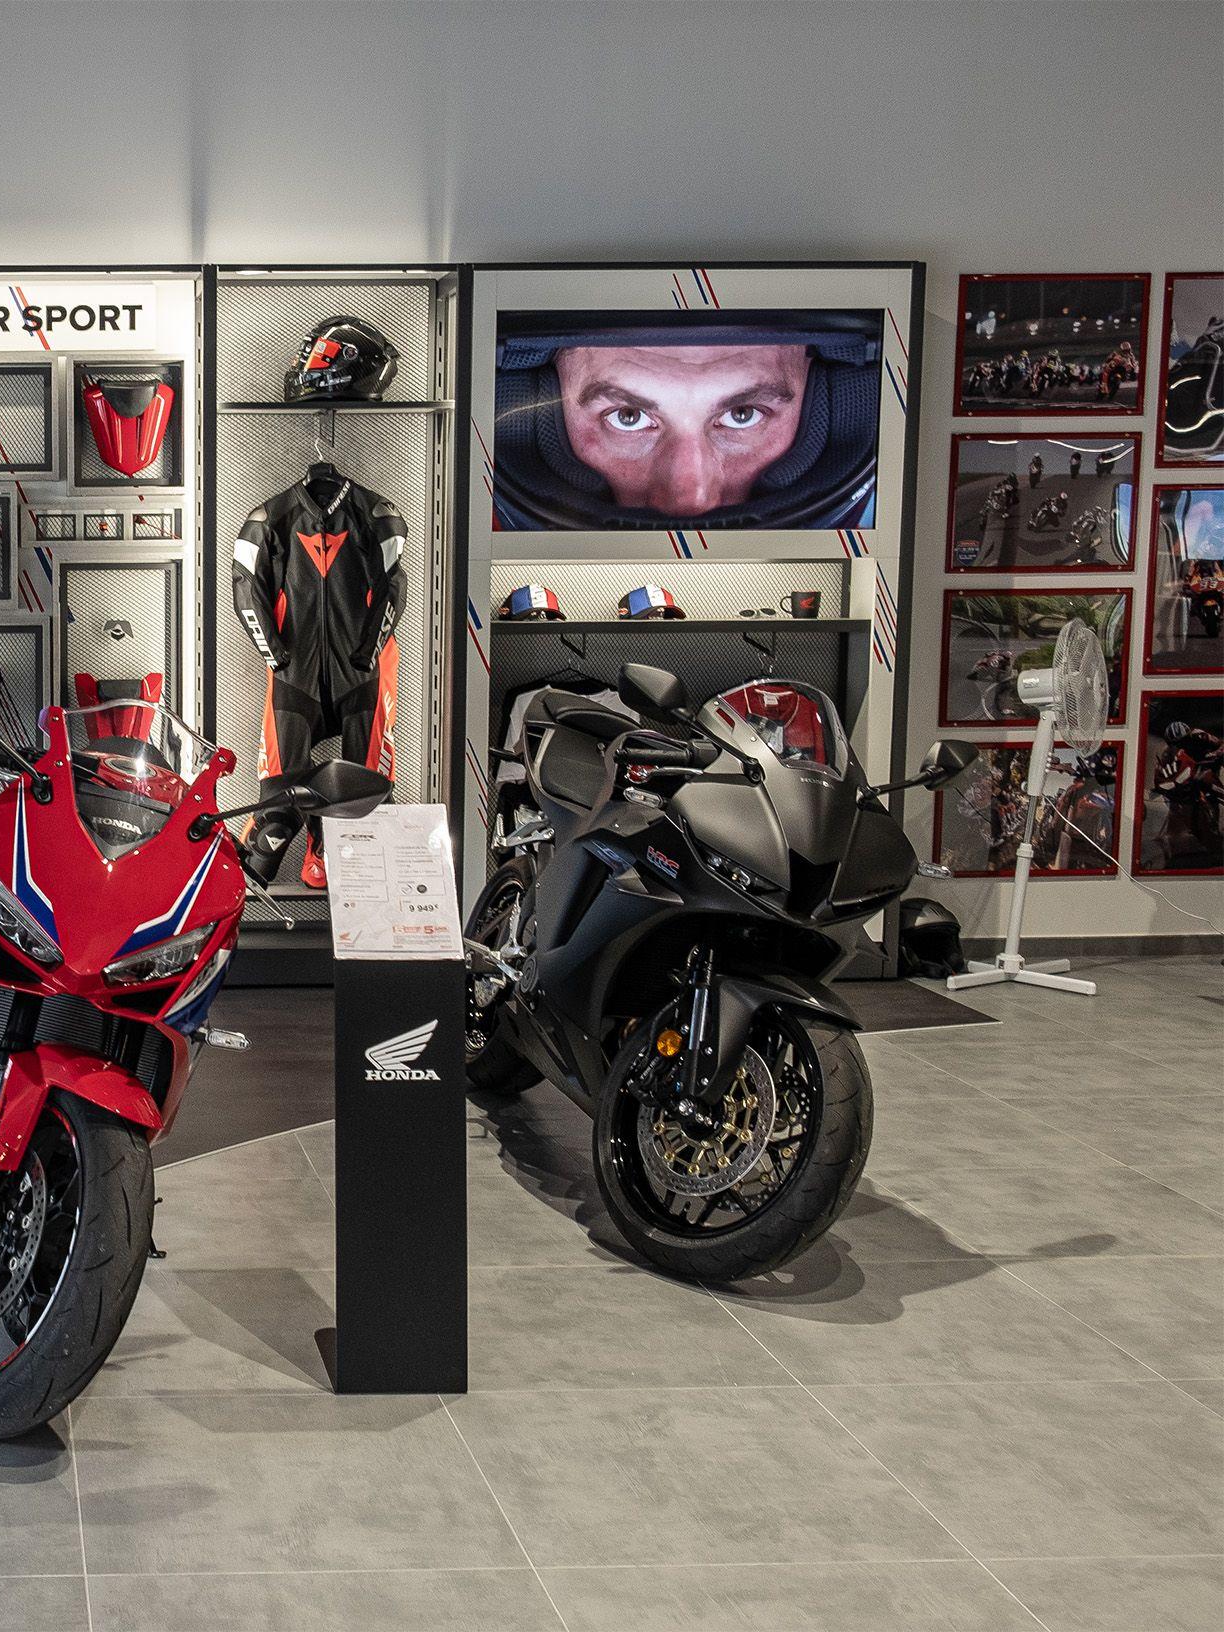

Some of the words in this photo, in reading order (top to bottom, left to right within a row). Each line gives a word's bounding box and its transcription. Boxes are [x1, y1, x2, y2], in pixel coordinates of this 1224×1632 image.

[21, 304, 144, 332] SPORT
[92, 816, 143, 835] HONDA
[364, 1069, 441, 1081] HONDA
